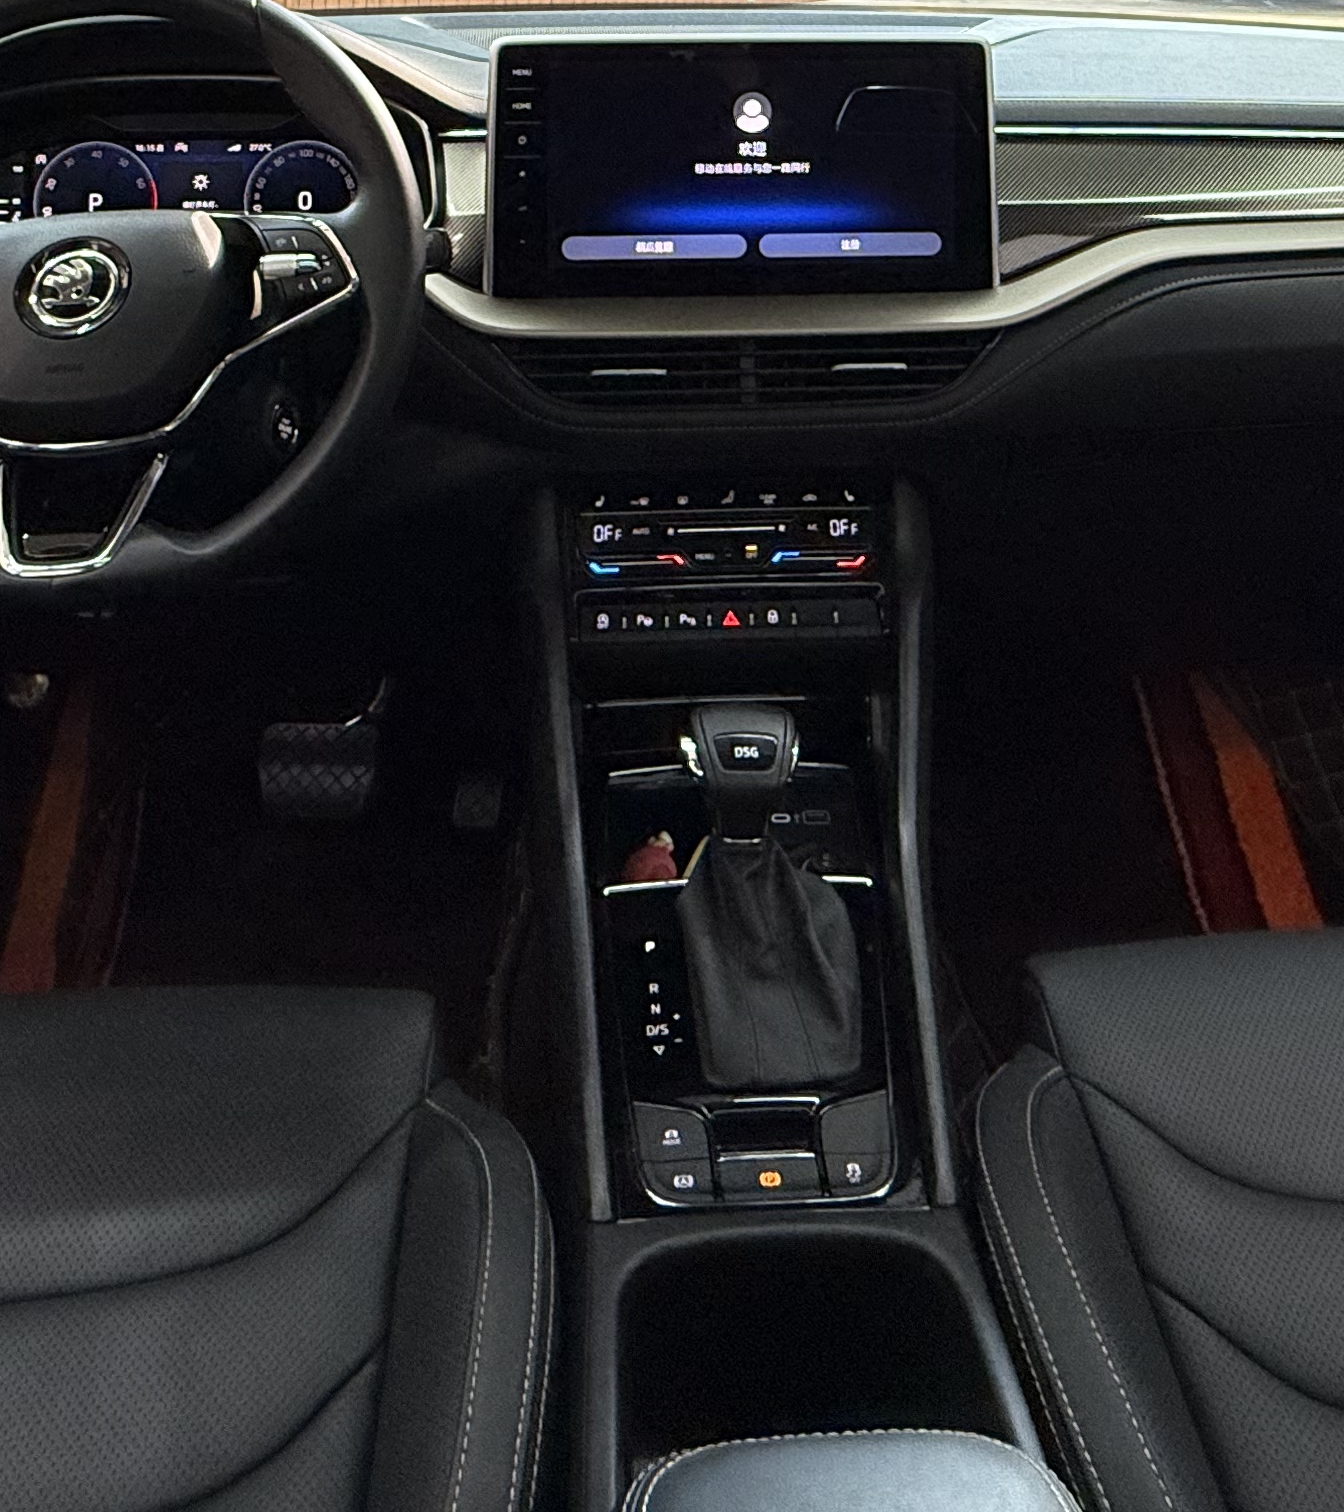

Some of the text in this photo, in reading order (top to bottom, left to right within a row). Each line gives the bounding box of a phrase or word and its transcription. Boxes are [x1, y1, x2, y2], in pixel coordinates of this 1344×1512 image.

[512, 68, 533, 76] MENU
[511, 102, 532, 110] HOME
[299, 149, 314, 157] 100
[738, 141, 767, 157] 欢迎
[88, 193, 104, 213] P
[297, 190, 313, 211] 0
[593, 523, 623, 543] OFF
[828, 517, 860, 537] OFF
[733, 745, 759, 759] DSG
[644, 940, 656, 953] P
[648, 982, 660, 995] R
[650, 1002, 662, 1016] N
[645, 1023, 670, 1037] D/S
